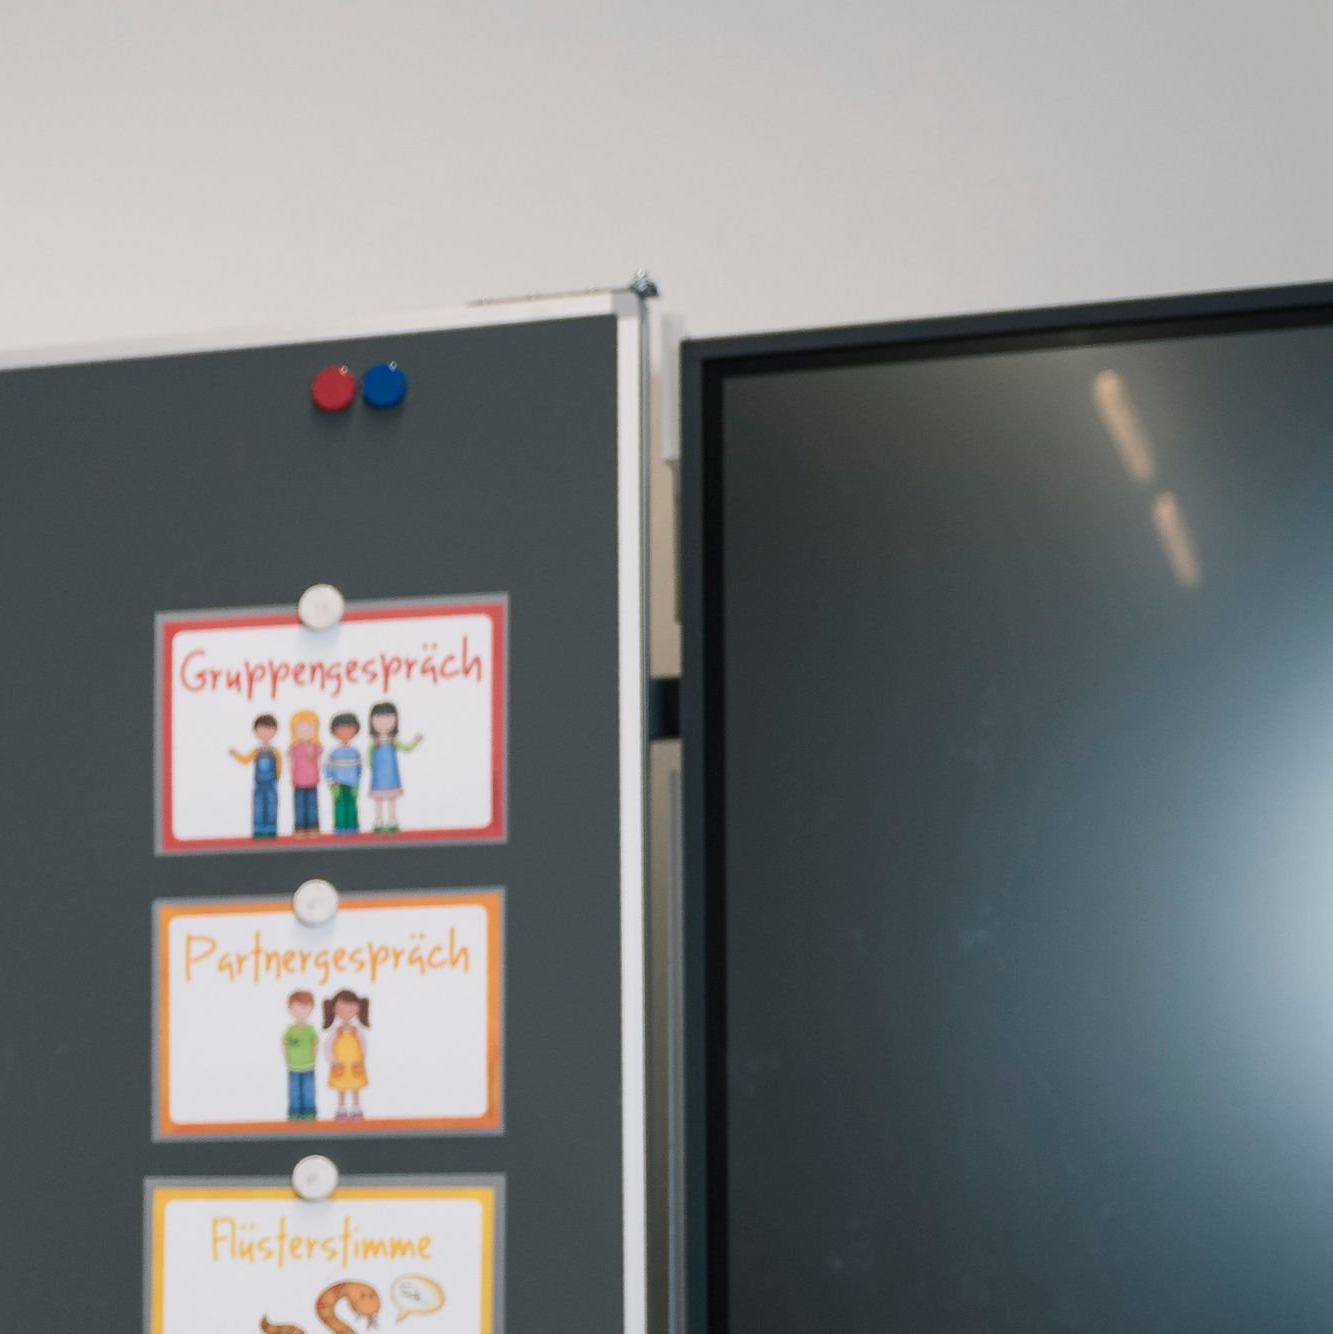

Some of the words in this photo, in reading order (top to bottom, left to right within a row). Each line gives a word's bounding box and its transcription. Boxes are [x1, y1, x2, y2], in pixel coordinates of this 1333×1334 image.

[180, 635, 482, 701] Gruppengespräch
[183, 926, 470, 985] Partnergespräch
[210, 1214, 432, 1269] Flüsterstimme
